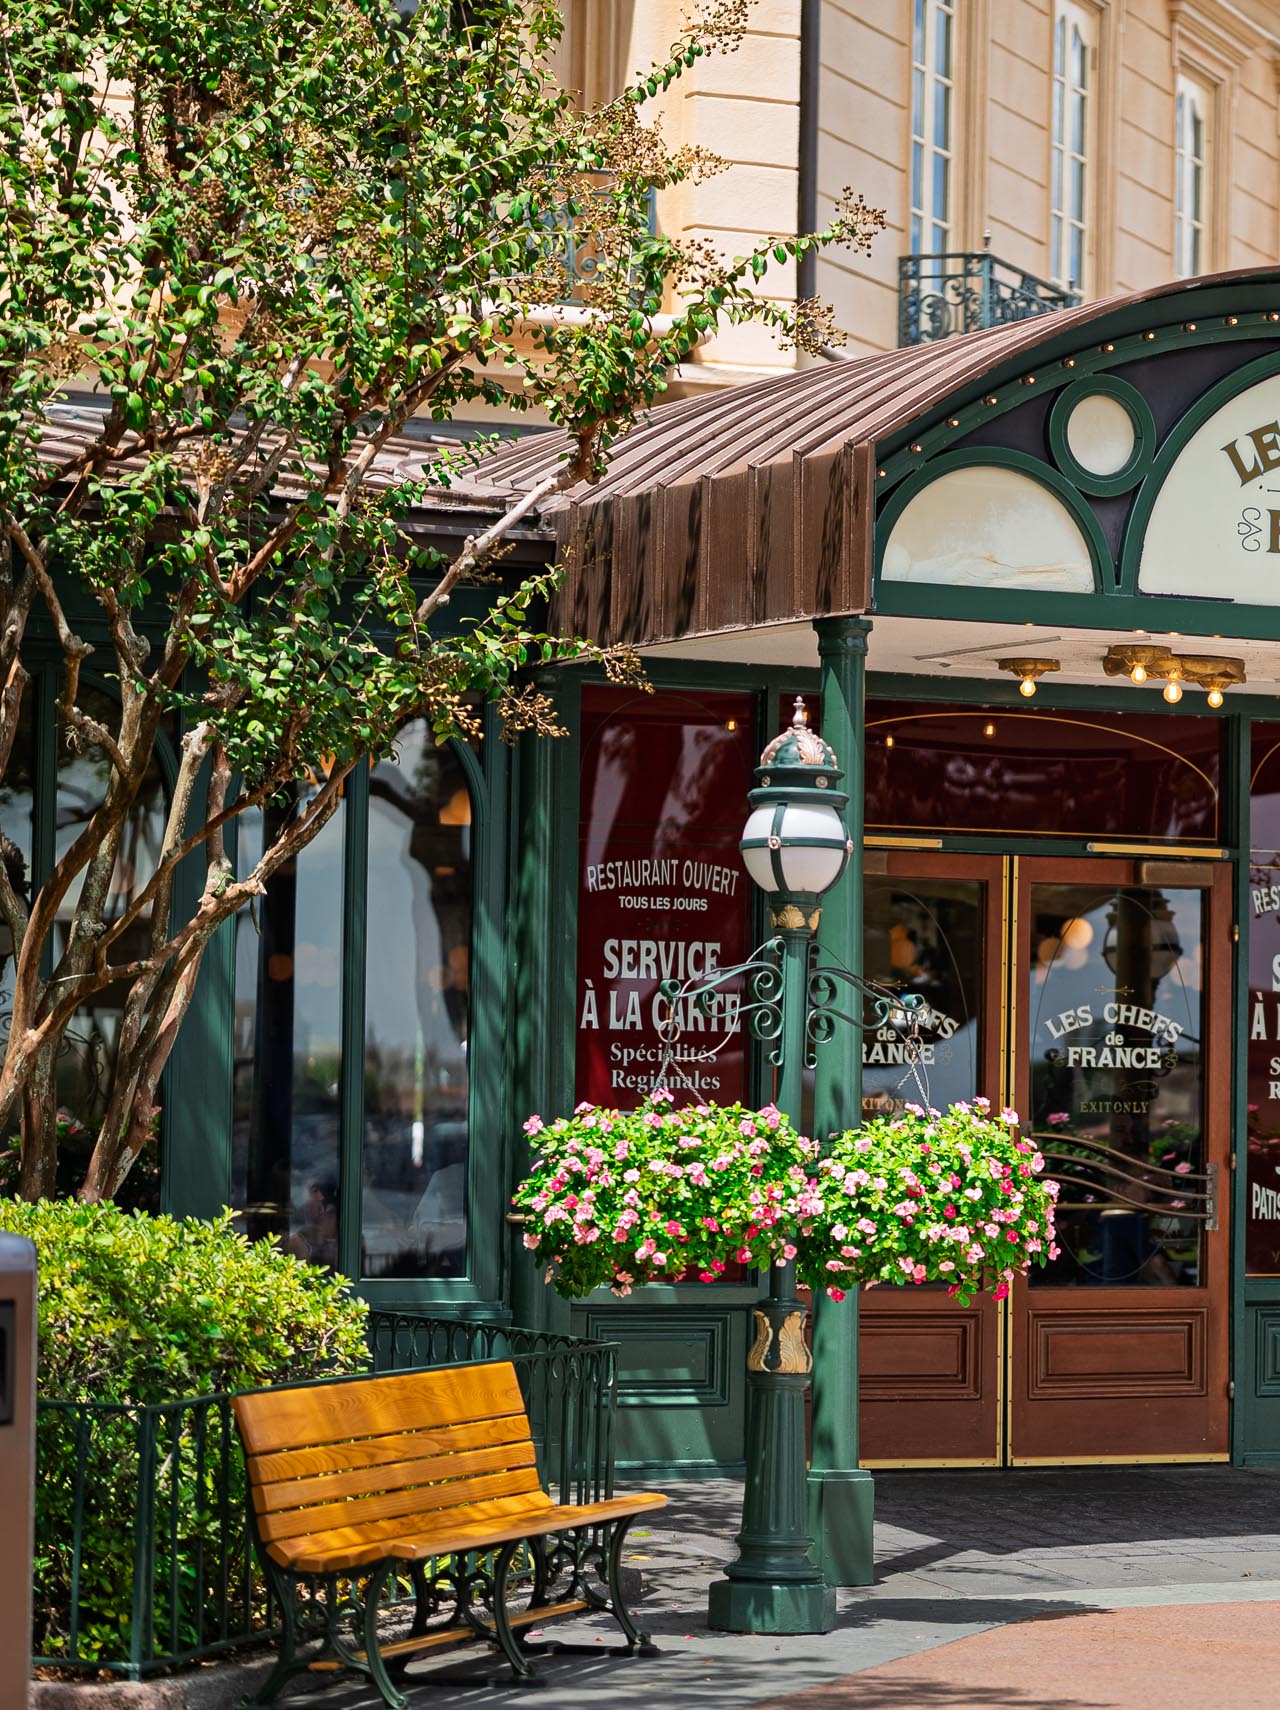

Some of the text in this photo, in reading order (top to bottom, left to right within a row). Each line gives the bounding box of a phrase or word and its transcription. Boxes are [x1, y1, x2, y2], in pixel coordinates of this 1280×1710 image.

[587, 859, 740, 896] RESTAURANT OUVERT
[619, 896, 708, 911] TOUS LES JOURS
[604, 938, 721, 981] SERVICE
[580, 979, 600, 1030] À
[608, 990, 643, 1030] LA
[1044, 1002, 1184, 1043] LES CHEFS
[1251, 992, 1267, 1040] À
[877, 1026, 897, 1041] de
[1105, 1031, 1124, 1046] de
[1066, 1046, 1162, 1069] FRANCE
